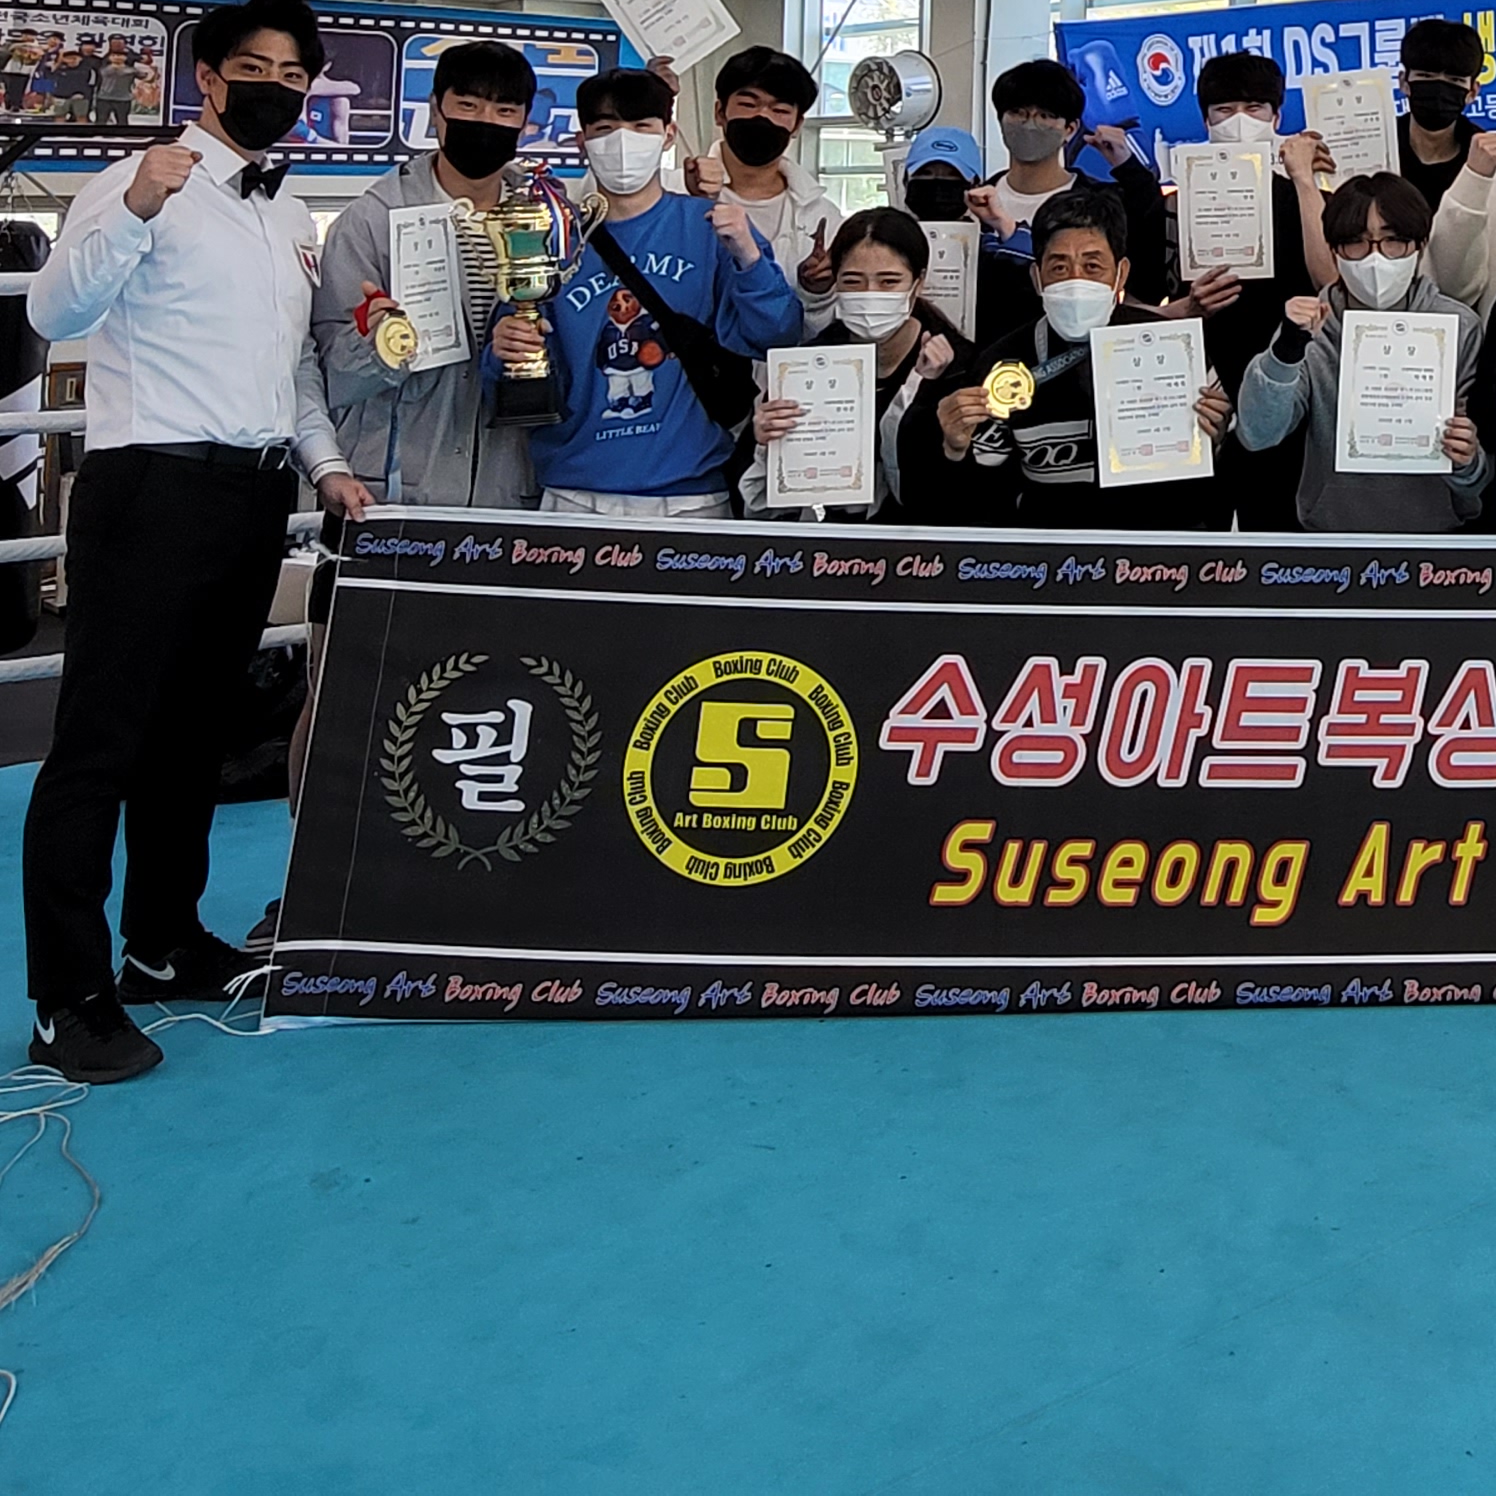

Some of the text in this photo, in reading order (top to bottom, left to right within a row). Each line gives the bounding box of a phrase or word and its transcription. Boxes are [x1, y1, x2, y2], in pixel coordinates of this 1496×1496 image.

[1283, 14, 1444, 89] DS그룹
[566, 253, 695, 312] DE MY
[355, 532, 445, 567] Suseong
[452, 535, 503, 562] Art
[511, 539, 585, 574] Boxing
[595, 544, 643, 567] Club
[656, 547, 746, 581] Suseong
[754, 549, 803, 578] Art
[812, 552, 886, 586] Boxing
[895, 554, 944, 578] Club
[958, 557, 1048, 589] Suseong
[1056, 556, 1106, 584] Art
[1114, 558, 1189, 592] Boxing
[1199, 560, 1247, 584] Club
[1260, 561, 1350, 593] Suseong
[1359, 560, 1410, 589] Art
[1418, 562, 1493, 594] Boxing
[713, 656, 800, 684] Boxing Club
[633, 674, 699, 751] Boxing Club
[808, 684, 855, 767] Boxing Club
[431, 698, 534, 812] 필
[627, 770, 673, 855] Boxing Club
[674, 812, 798, 831] Art Boxing Club
[787, 780, 850, 859] Boxing Club
[685, 855, 775, 881] Boxing Club
[929, 819, 1310, 927] Suseong
[1338, 820, 1487, 907] Art
[281, 972, 377, 1006] Suseong
[383, 970, 438, 1002] Art
[443, 975, 523, 1013] Boxing
[530, 979, 583, 1004] Club
[595, 981, 692, 1015] Suseong
[698, 980, 752, 1010] Art
[760, 981, 840, 1015] Boxing
[849, 982, 900, 1006] Club
[914, 984, 1010, 1012] Suseong
[1018, 980, 1072, 1009] Art
[1081, 981, 1160, 1008] Boxing
[1169, 980, 1222, 1004] Club
[1340, 977, 1394, 1005] Art
